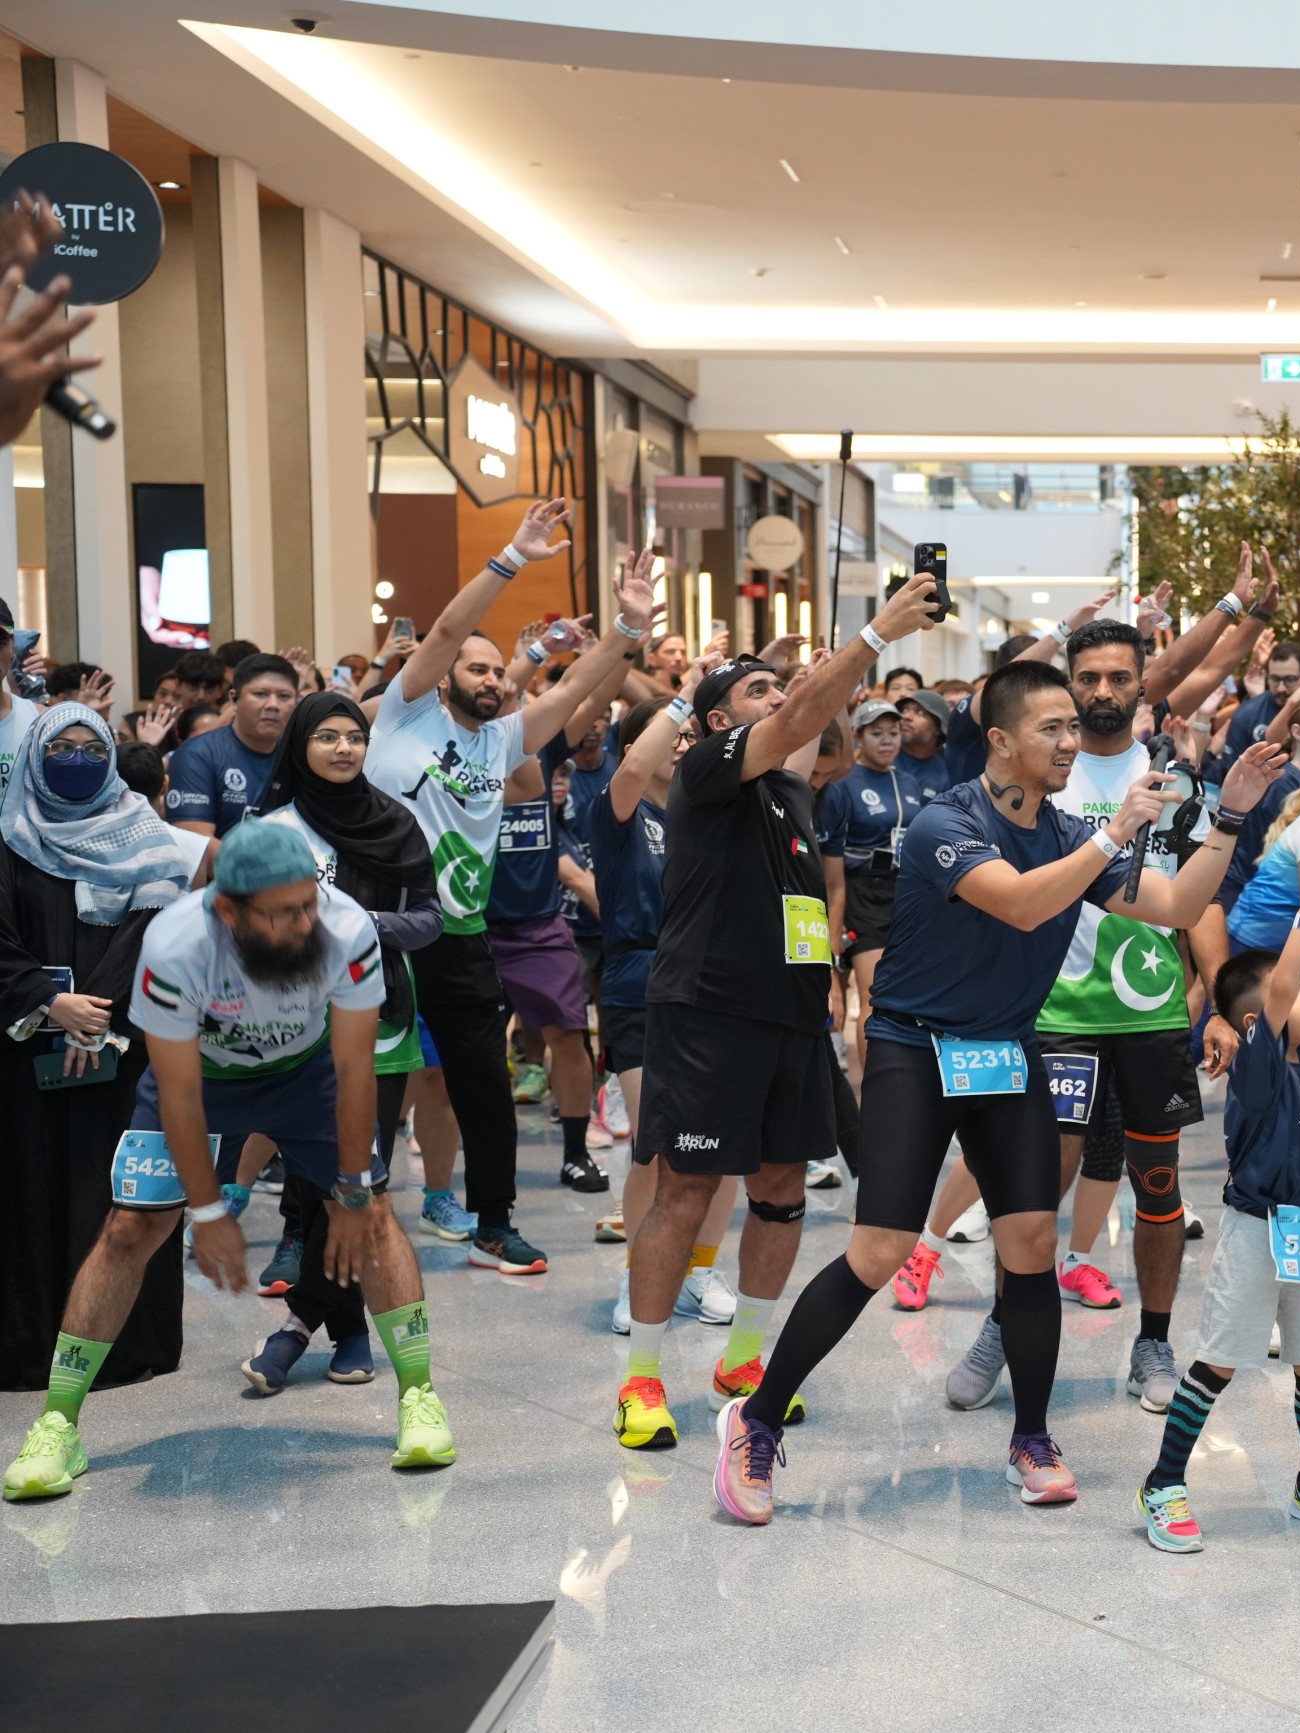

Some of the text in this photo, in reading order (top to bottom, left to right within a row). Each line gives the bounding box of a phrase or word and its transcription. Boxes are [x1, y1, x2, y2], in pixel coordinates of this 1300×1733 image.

[54, 244, 98, 258] iCoffee
[501, 819, 544, 834] 24005
[951, 1047, 1023, 1070] 52319
[1164, 1102, 1190, 1113] adidas
[689, 1137, 720, 1150] RUN
